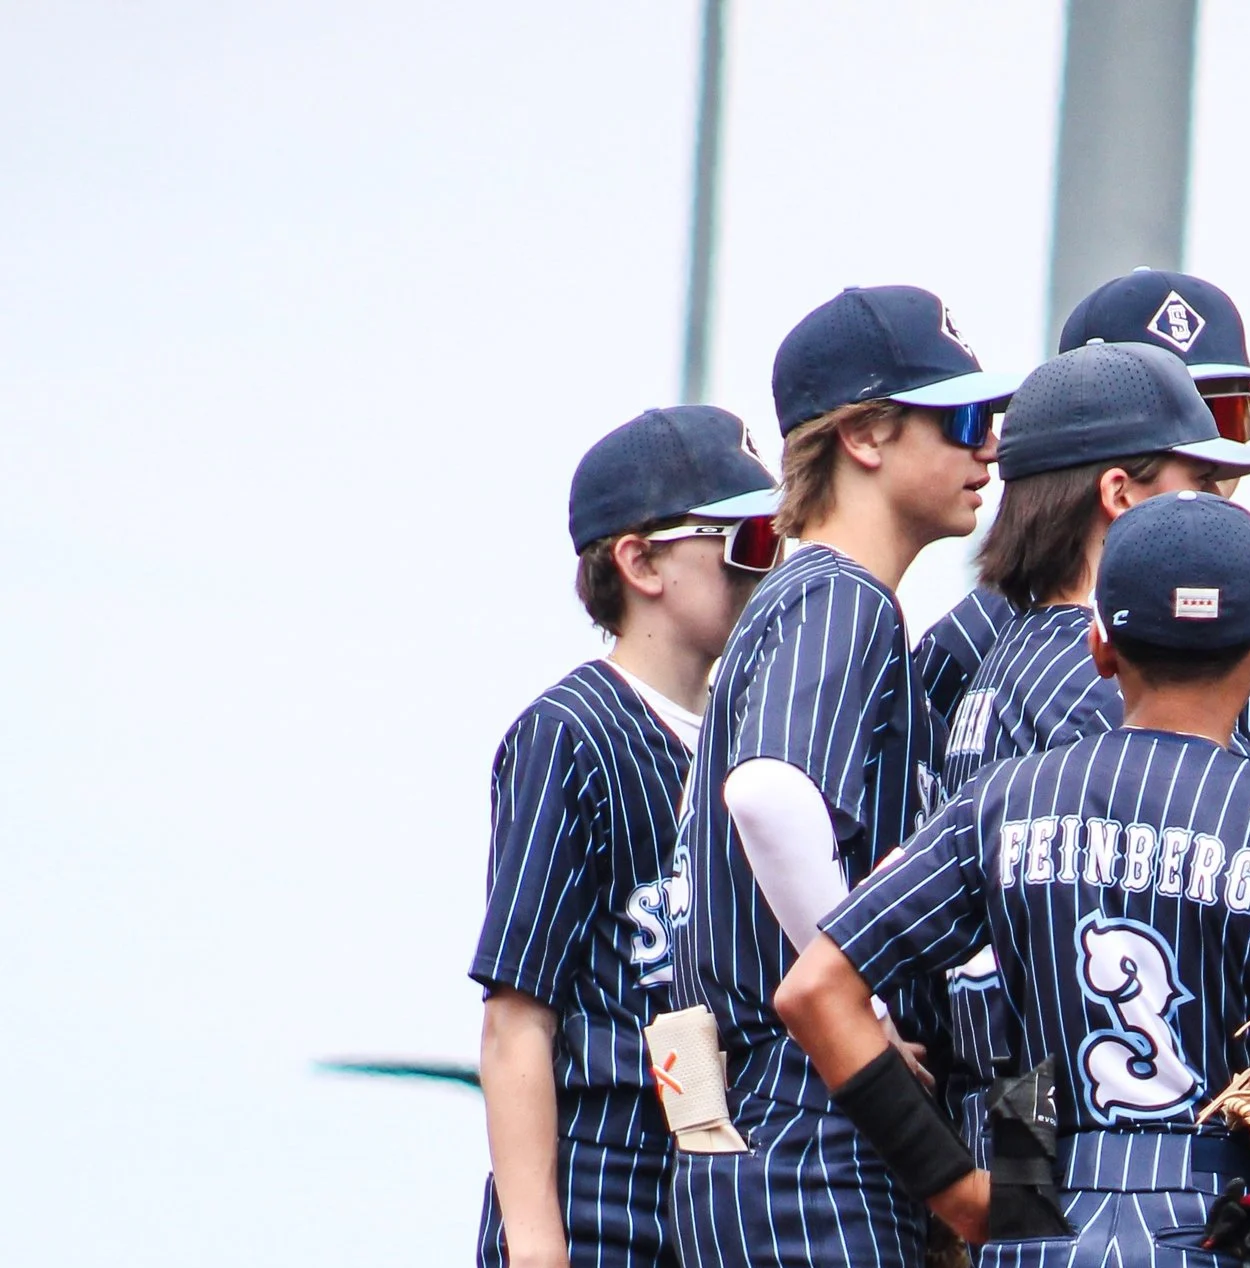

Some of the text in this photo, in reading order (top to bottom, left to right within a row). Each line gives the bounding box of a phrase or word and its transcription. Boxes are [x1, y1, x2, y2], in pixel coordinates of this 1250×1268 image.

[1166, 303, 1192, 341] S
[945, 686, 996, 760] HEA
[1074, 908, 1206, 1125] 3
